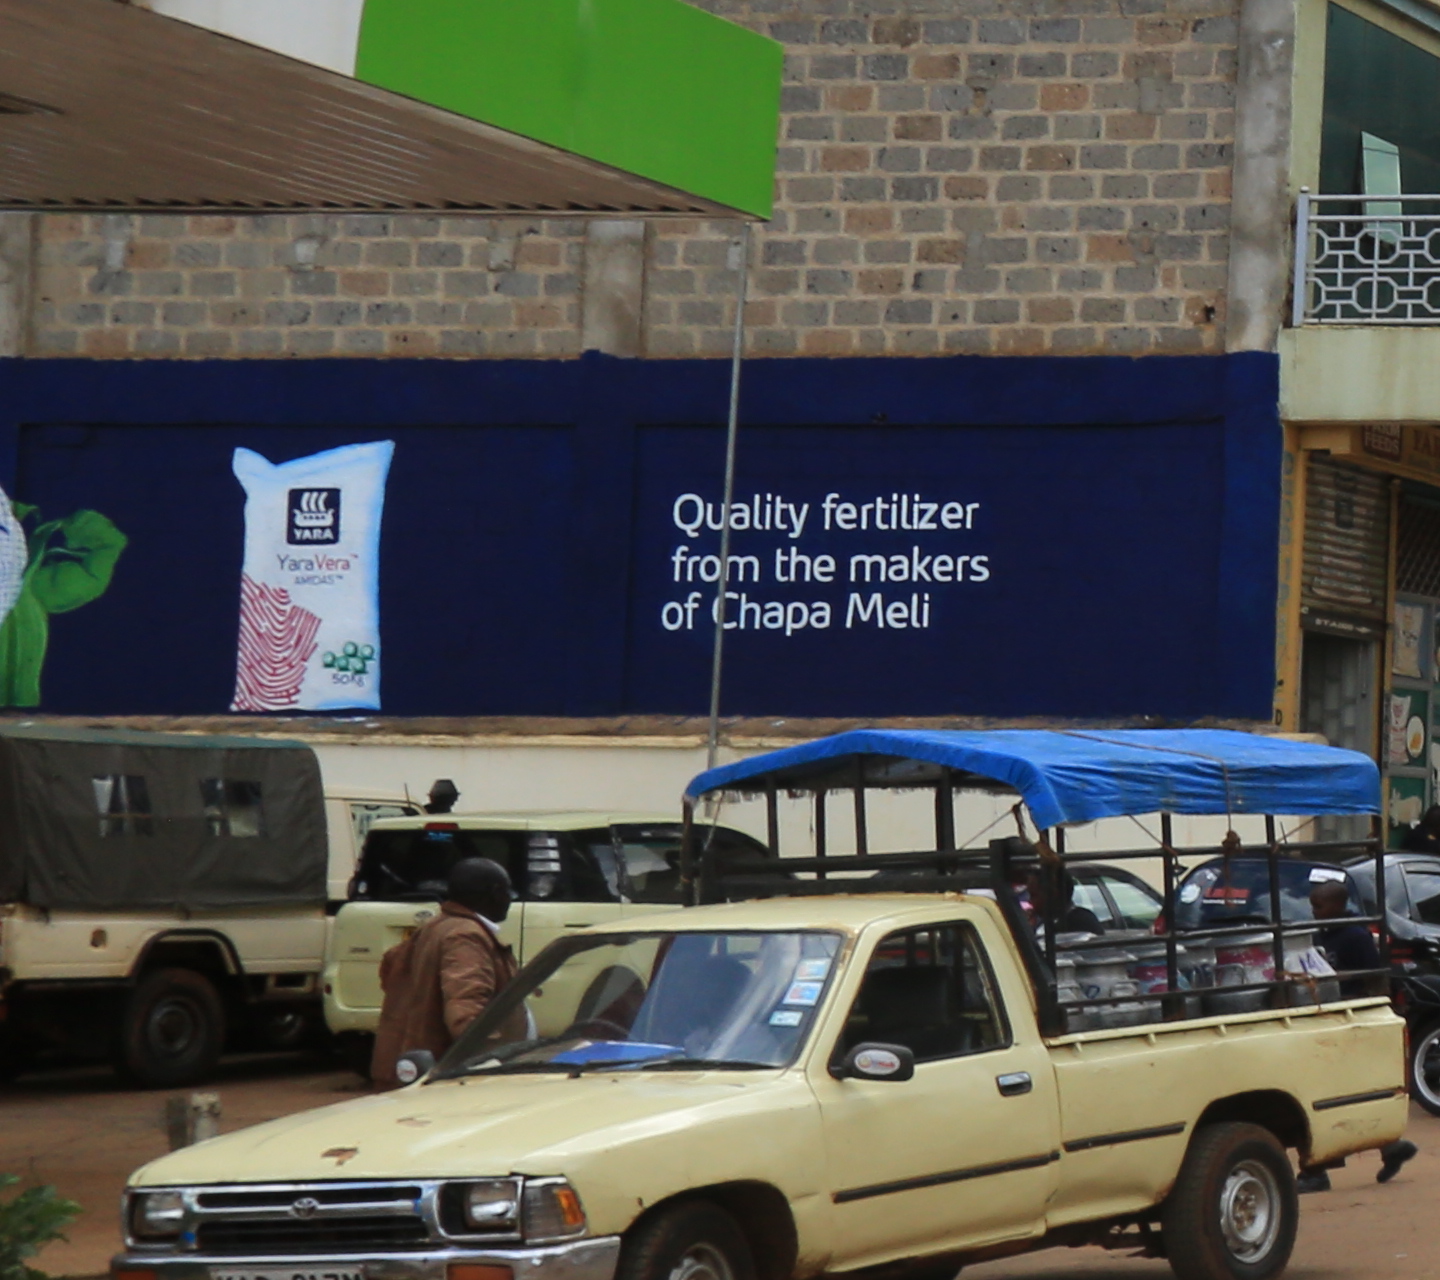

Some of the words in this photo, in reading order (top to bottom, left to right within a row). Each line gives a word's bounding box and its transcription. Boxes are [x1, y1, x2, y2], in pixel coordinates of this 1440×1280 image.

[294, 528, 334, 540] YARA
[673, 493, 809, 538] Quality
[822, 493, 980, 531] fertilizer
[672, 545, 760, 582] from
[775, 546, 836, 582] the
[849, 545, 990, 582] makers
[661, 591, 702, 631] of
[712, 591, 831, 637] Chapa
[845, 592, 930, 629] Meli
